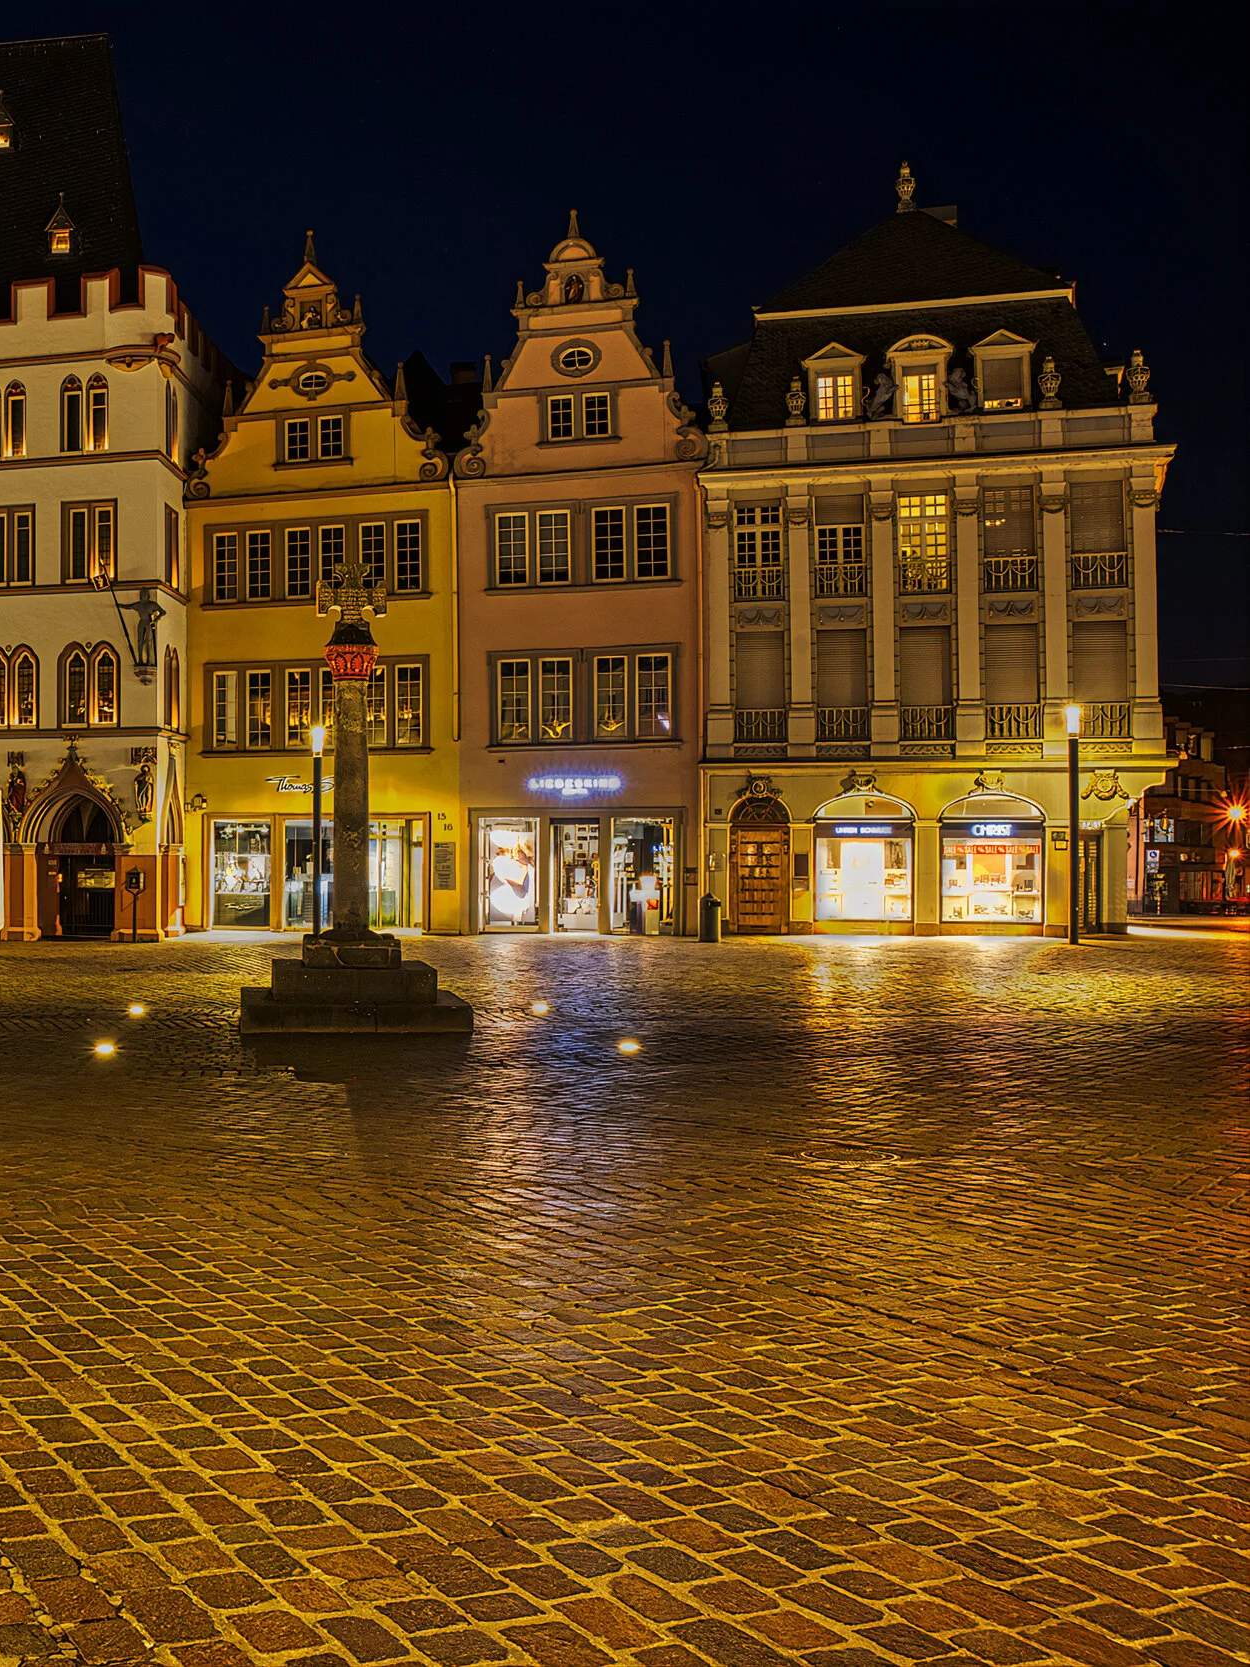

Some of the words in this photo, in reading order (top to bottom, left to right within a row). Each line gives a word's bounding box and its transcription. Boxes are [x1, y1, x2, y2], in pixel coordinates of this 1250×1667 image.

[437, 812, 447, 821] 15
[443, 823, 454, 832] 16
[971, 824, 1012, 836] CHRIST
[985, 845, 997, 854] SALE
